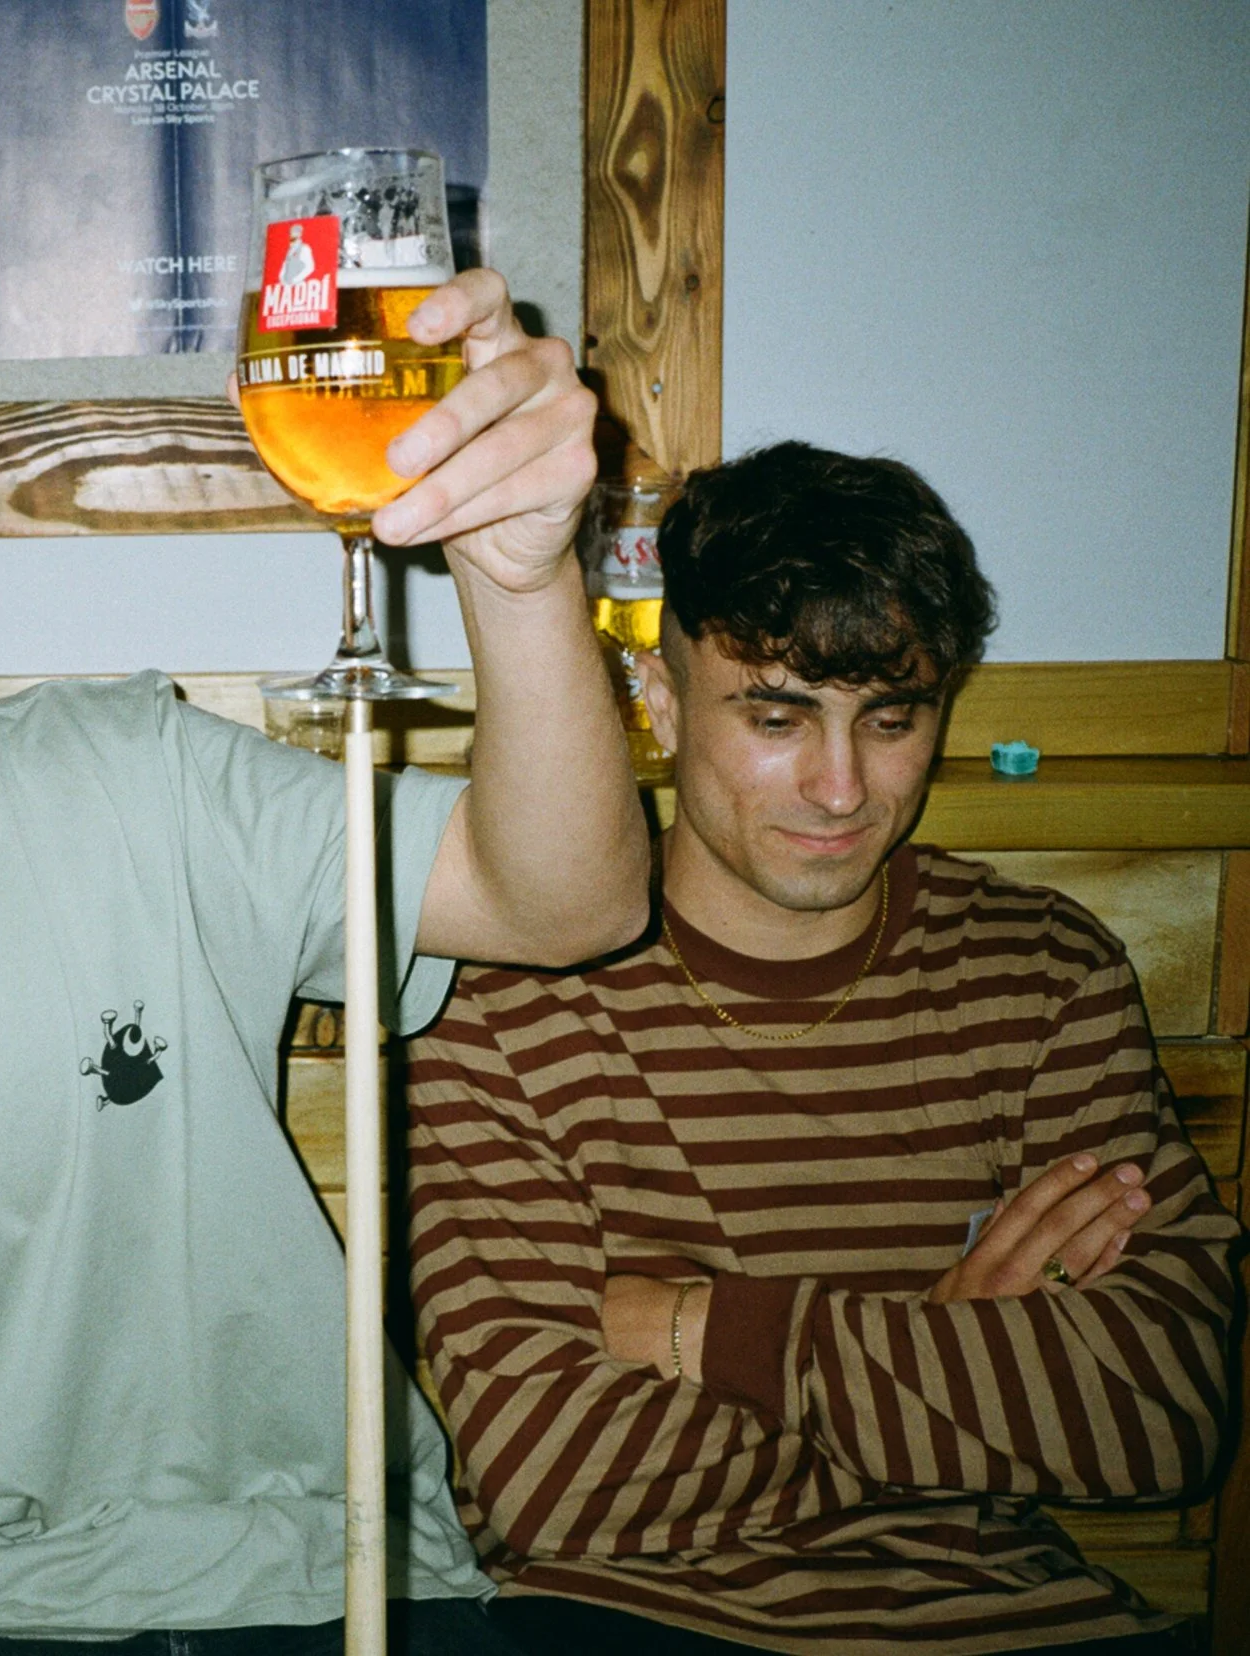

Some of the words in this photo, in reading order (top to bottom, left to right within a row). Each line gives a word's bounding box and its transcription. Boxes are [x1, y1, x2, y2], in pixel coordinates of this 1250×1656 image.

[125, 60, 221, 81] ARSENAL
[86, 84, 177, 104] CRYSTAL
[180, 80, 260, 100] PALACE
[118, 256, 184, 274] WATCH
[188, 256, 237, 273] HERE
[249, 357, 283, 384] ALMA
[288, 354, 308, 380] DE
